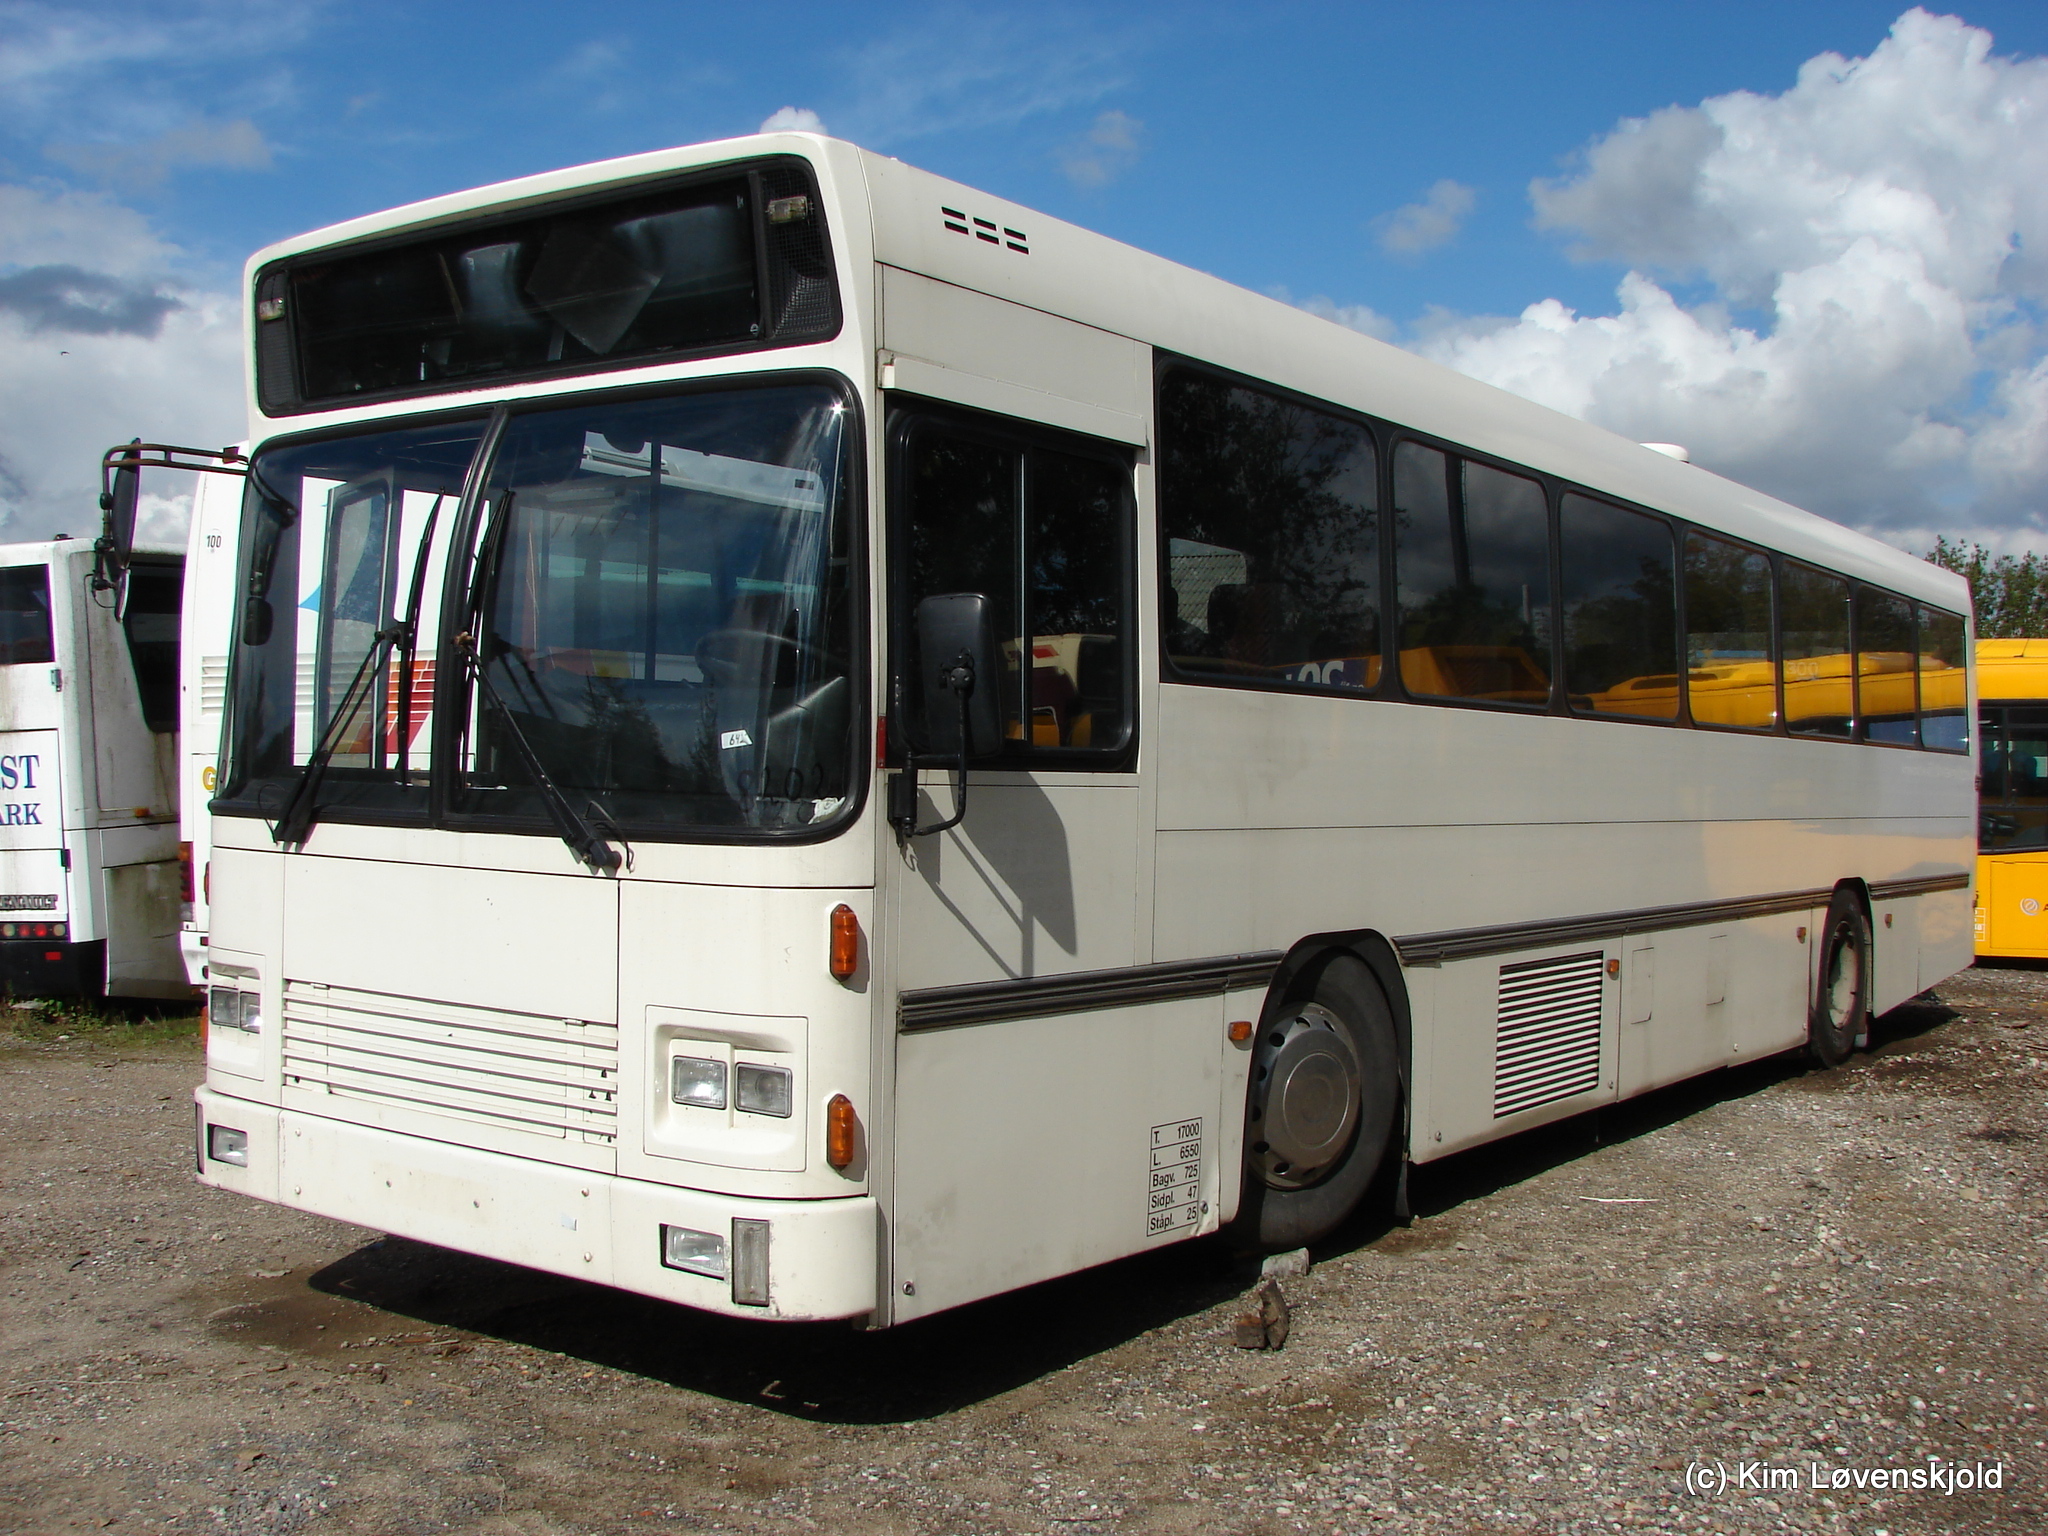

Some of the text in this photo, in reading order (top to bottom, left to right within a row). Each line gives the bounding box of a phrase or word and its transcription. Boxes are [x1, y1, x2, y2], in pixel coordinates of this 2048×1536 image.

[207, 535, 222, 548] 100
[0, 894, 58, 911] ENAULT
[1177, 1123, 1199, 1139] 17000
[1180, 1143, 1199, 1159] 6550
[1153, 1164, 1198, 1187] Bagv. 725
[1151, 1186, 1197, 1208] Sidpl. 47
[1187, 1207, 1197, 1220] 25
